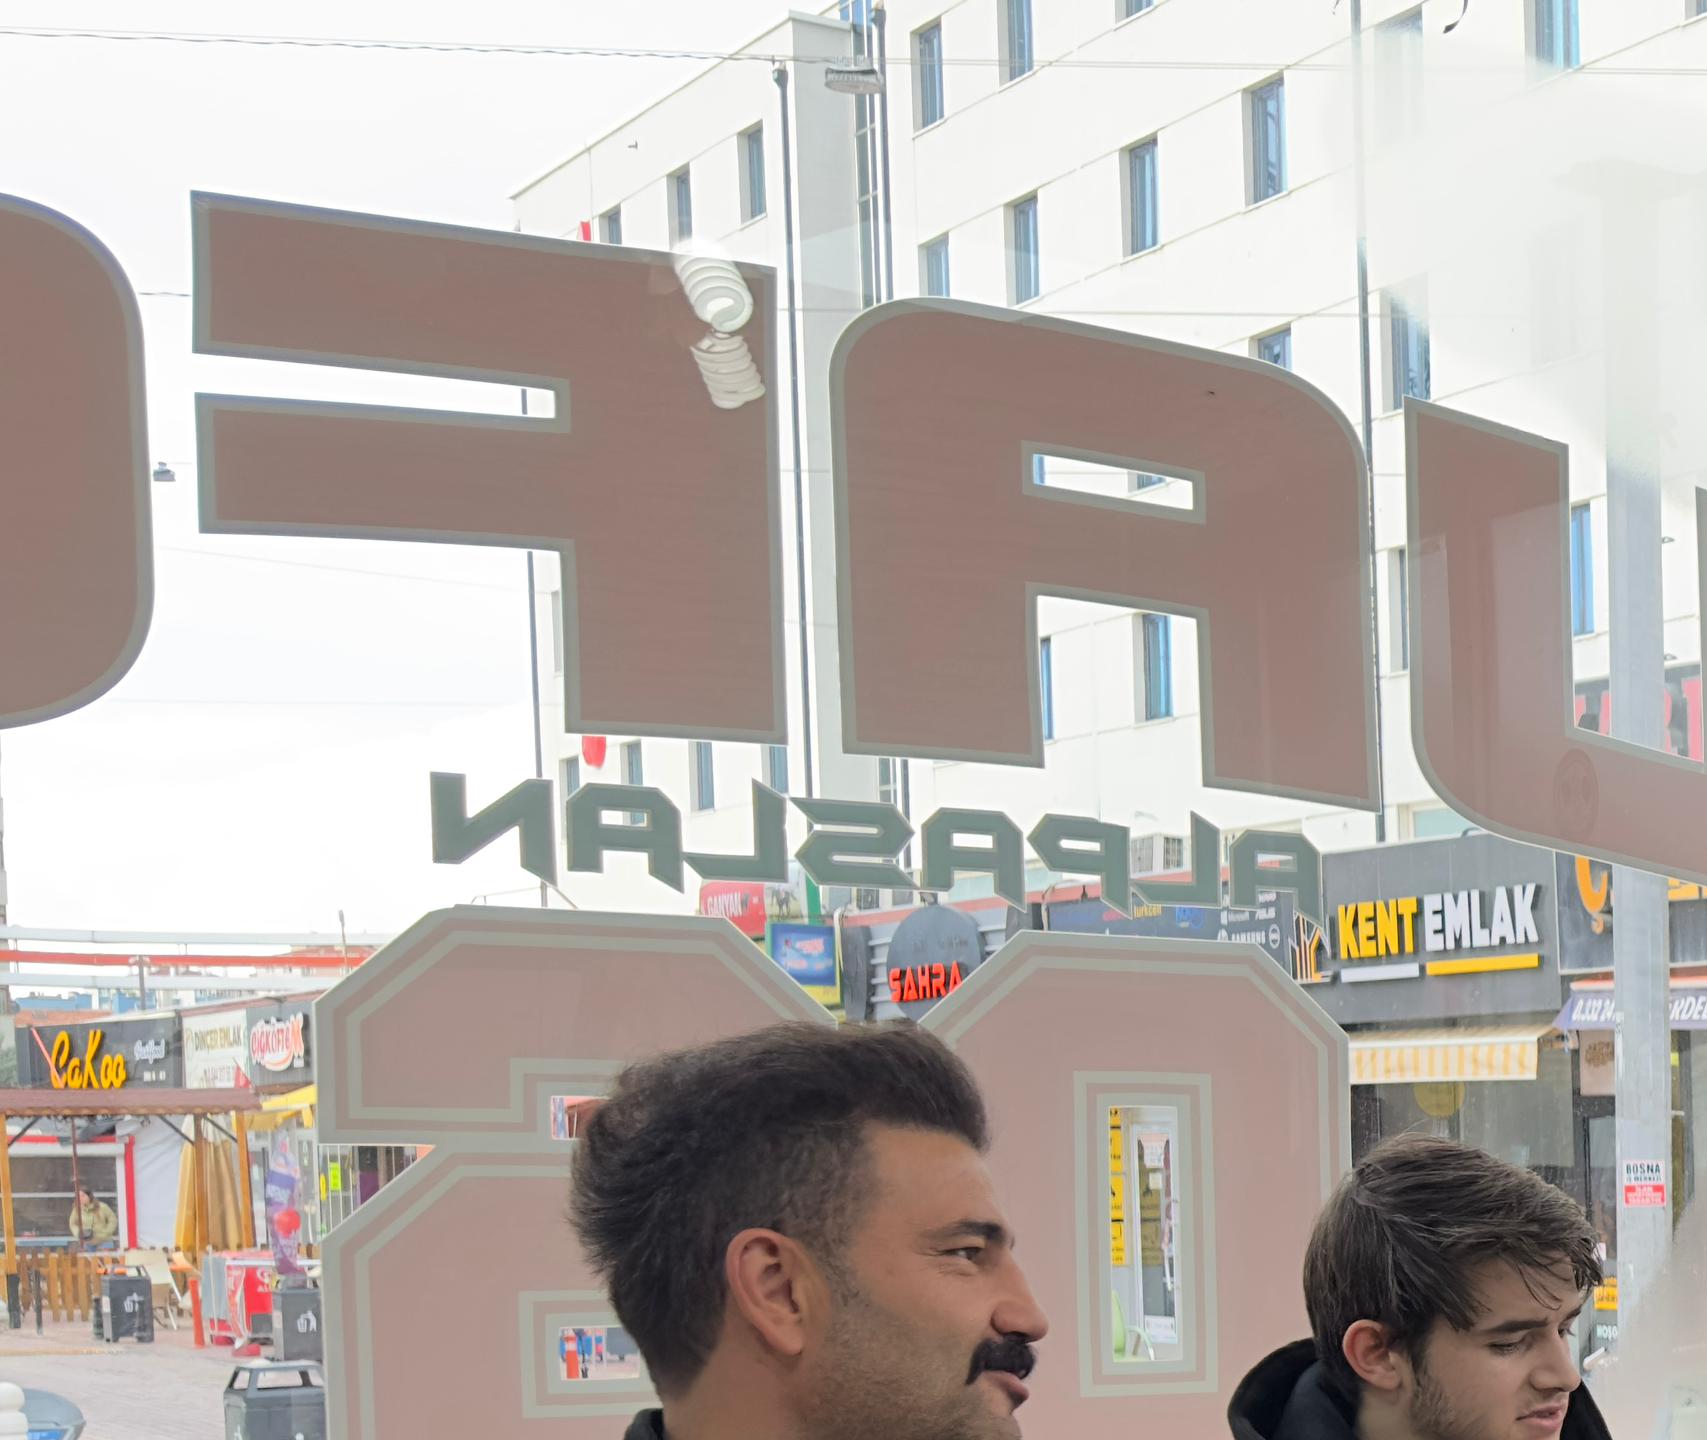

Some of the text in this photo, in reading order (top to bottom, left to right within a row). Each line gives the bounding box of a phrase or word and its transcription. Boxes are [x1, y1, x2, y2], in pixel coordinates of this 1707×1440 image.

[1337, 896, 1418, 960] KENT
[1423, 882, 1540, 952] EMLAK
[888, 960, 963, 1003] SAHRA
[1625, 1163, 1661, 1175] BOSNA
